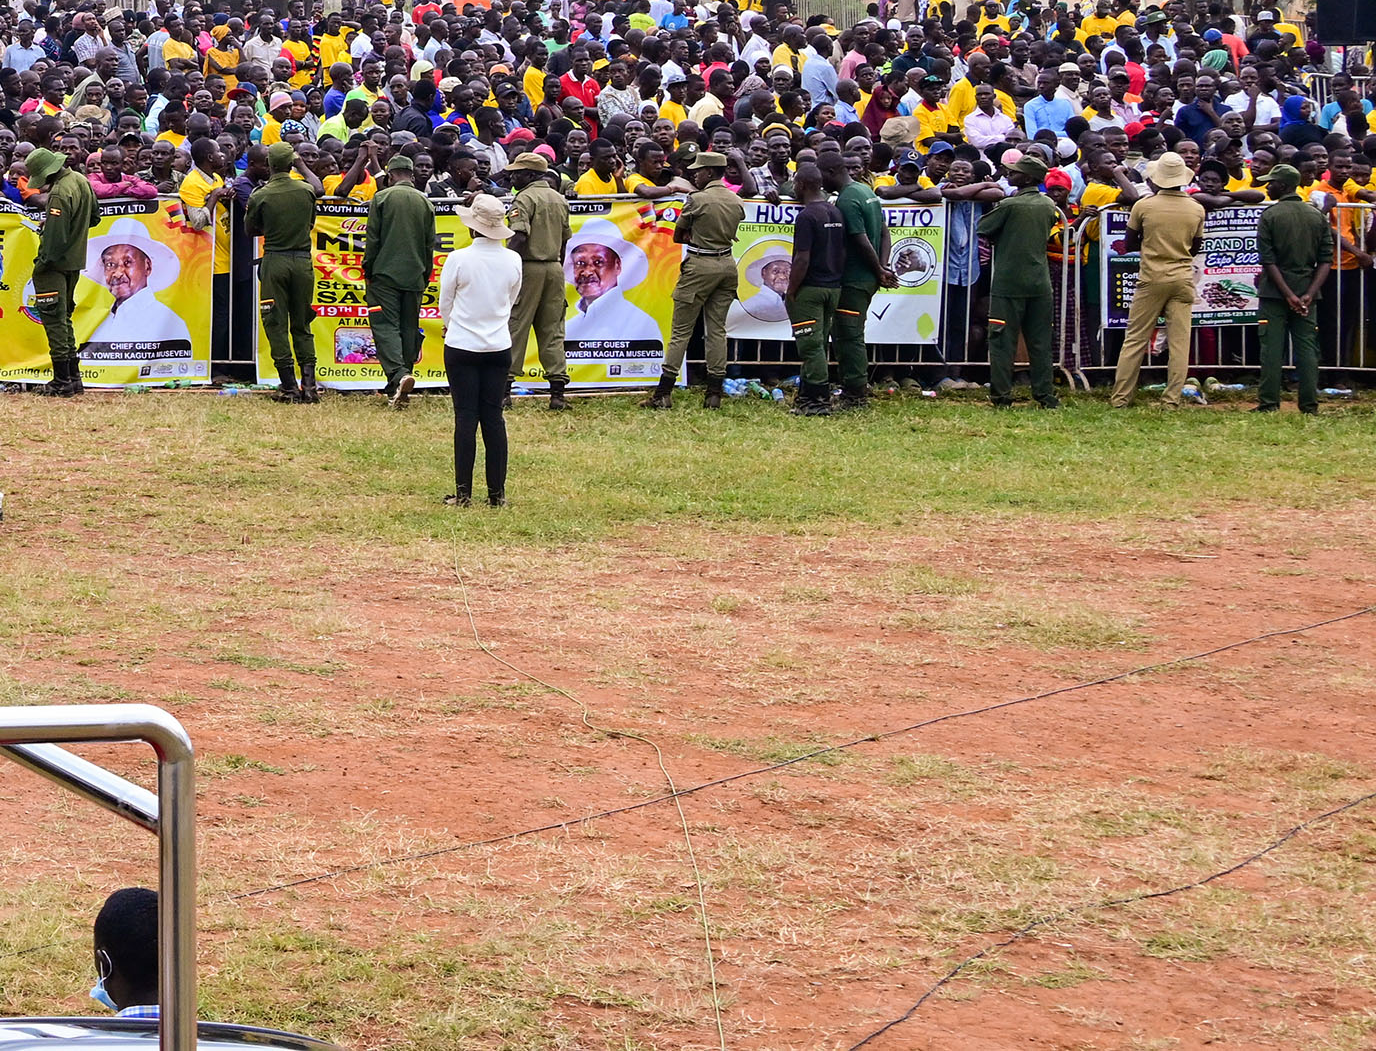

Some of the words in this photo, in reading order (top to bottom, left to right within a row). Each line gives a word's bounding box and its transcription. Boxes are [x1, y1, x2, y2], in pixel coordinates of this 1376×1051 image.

[98, 205, 125, 216] CIETY
[128, 204, 146, 214] LTD
[323, 205, 350, 214] YOUTH
[353, 206, 369, 215] MIX
[589, 203, 605, 213] LTD
[1208, 210, 1235, 220] PDM
[1237, 209, 1262, 219] SAC
[738, 224, 775, 233] GHETTO
[1206, 252, 1233, 267] Expo
[1235, 252, 1260, 264] 202
[1233, 266, 1262, 274] REGION
[317, 305, 353, 317] 19TH
[110, 342, 134, 351] CHIEF
[135, 342, 161, 350] GUEST
[578, 341, 602, 349] CHIEF
[603, 341, 630, 349] GUEST
[92, 351, 123, 360] YOWERI
[124, 351, 156, 360] KAGUTA
[156, 349, 193, 359] MUSEVENI
[565, 351, 592, 359] OWERI
[593, 350, 625, 359] KAGUTA
[625, 350, 664, 358] MUSEVENI
